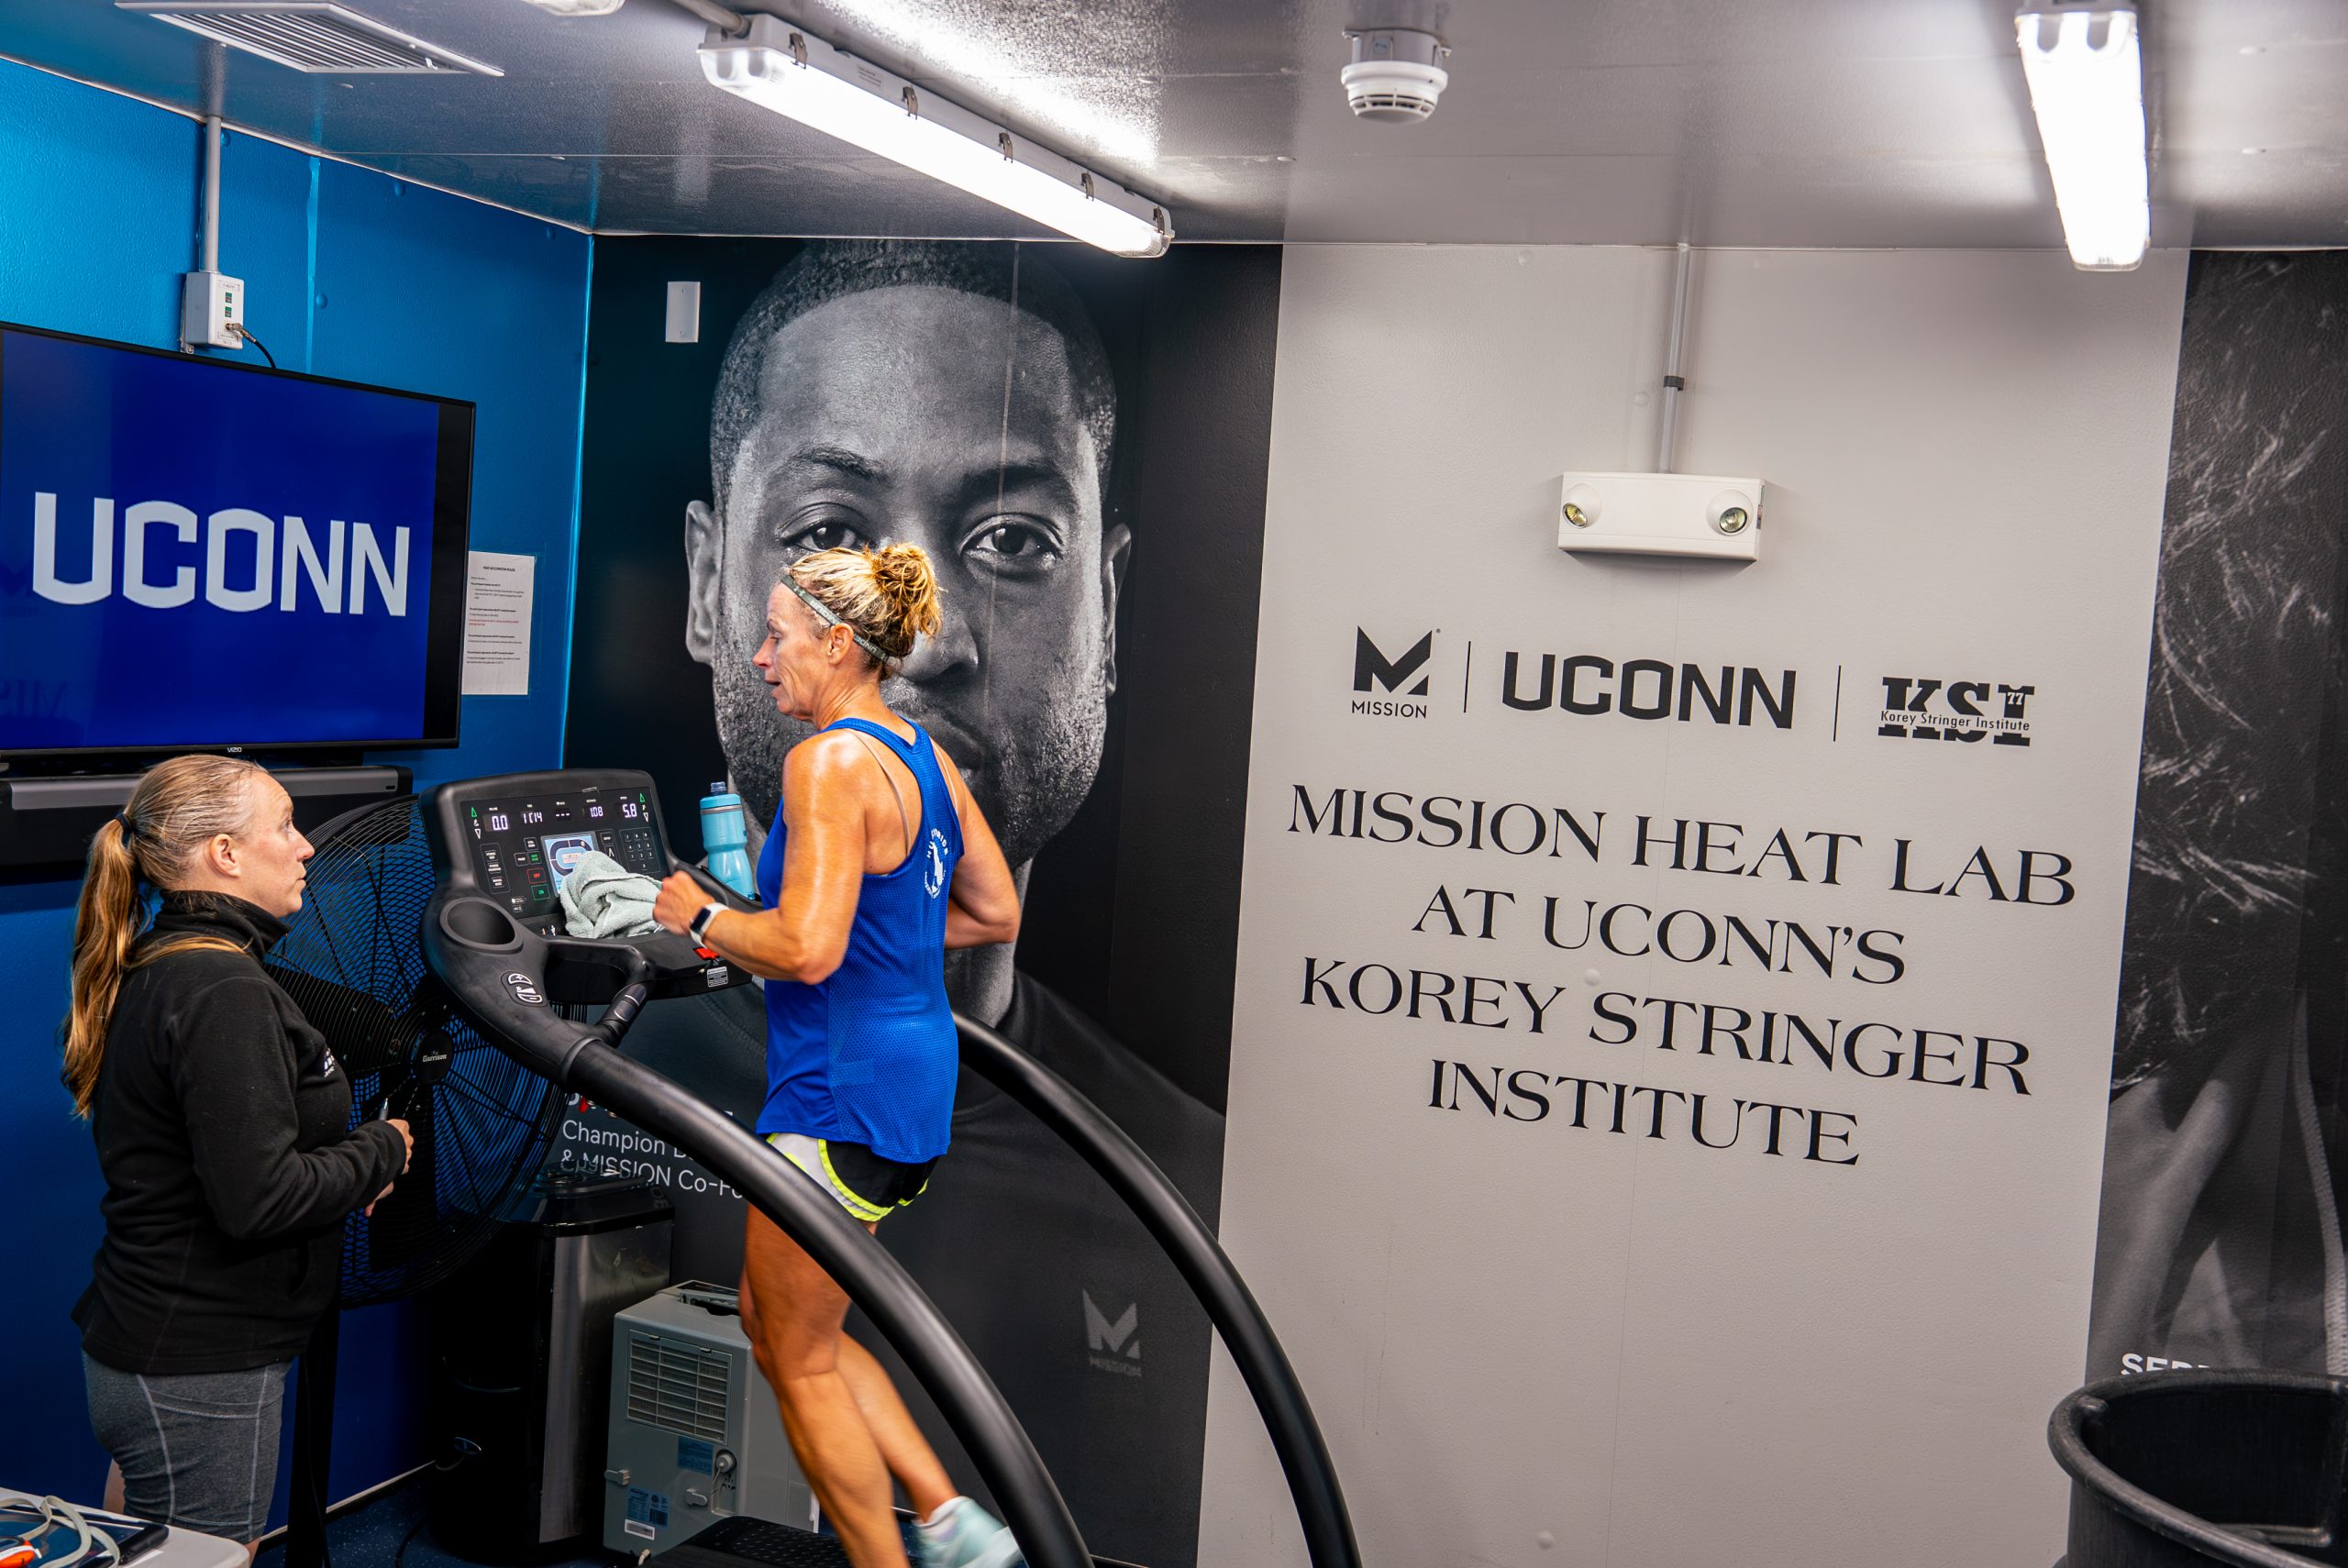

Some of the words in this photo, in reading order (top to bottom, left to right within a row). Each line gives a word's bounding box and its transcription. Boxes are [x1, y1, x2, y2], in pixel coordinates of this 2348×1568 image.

[33, 492, 410, 617] UCONN
[1351, 700, 1427, 719] MISSION
[1502, 652, 1796, 729] UCONN
[1878, 677, 2035, 747] KSI
[1880, 711, 1917, 724] Korey
[1921, 712, 1972, 728] Stringer
[1976, 716, 2031, 731] Institute
[2007, 692, 2024, 706] 77
[1288, 785, 1607, 862] MISSION
[1632, 816, 1863, 885] HEAT
[1889, 839, 2076, 906] LAB
[1412, 885, 1515, 940] AT
[1545, 897, 1905, 984] UCONN'S
[1301, 957, 1567, 1034] KOREY
[1589, 992, 2032, 1096] STRINGER
[562, 1120, 666, 1155] Champion
[1428, 1059, 1860, 1166] INSTITUTE
